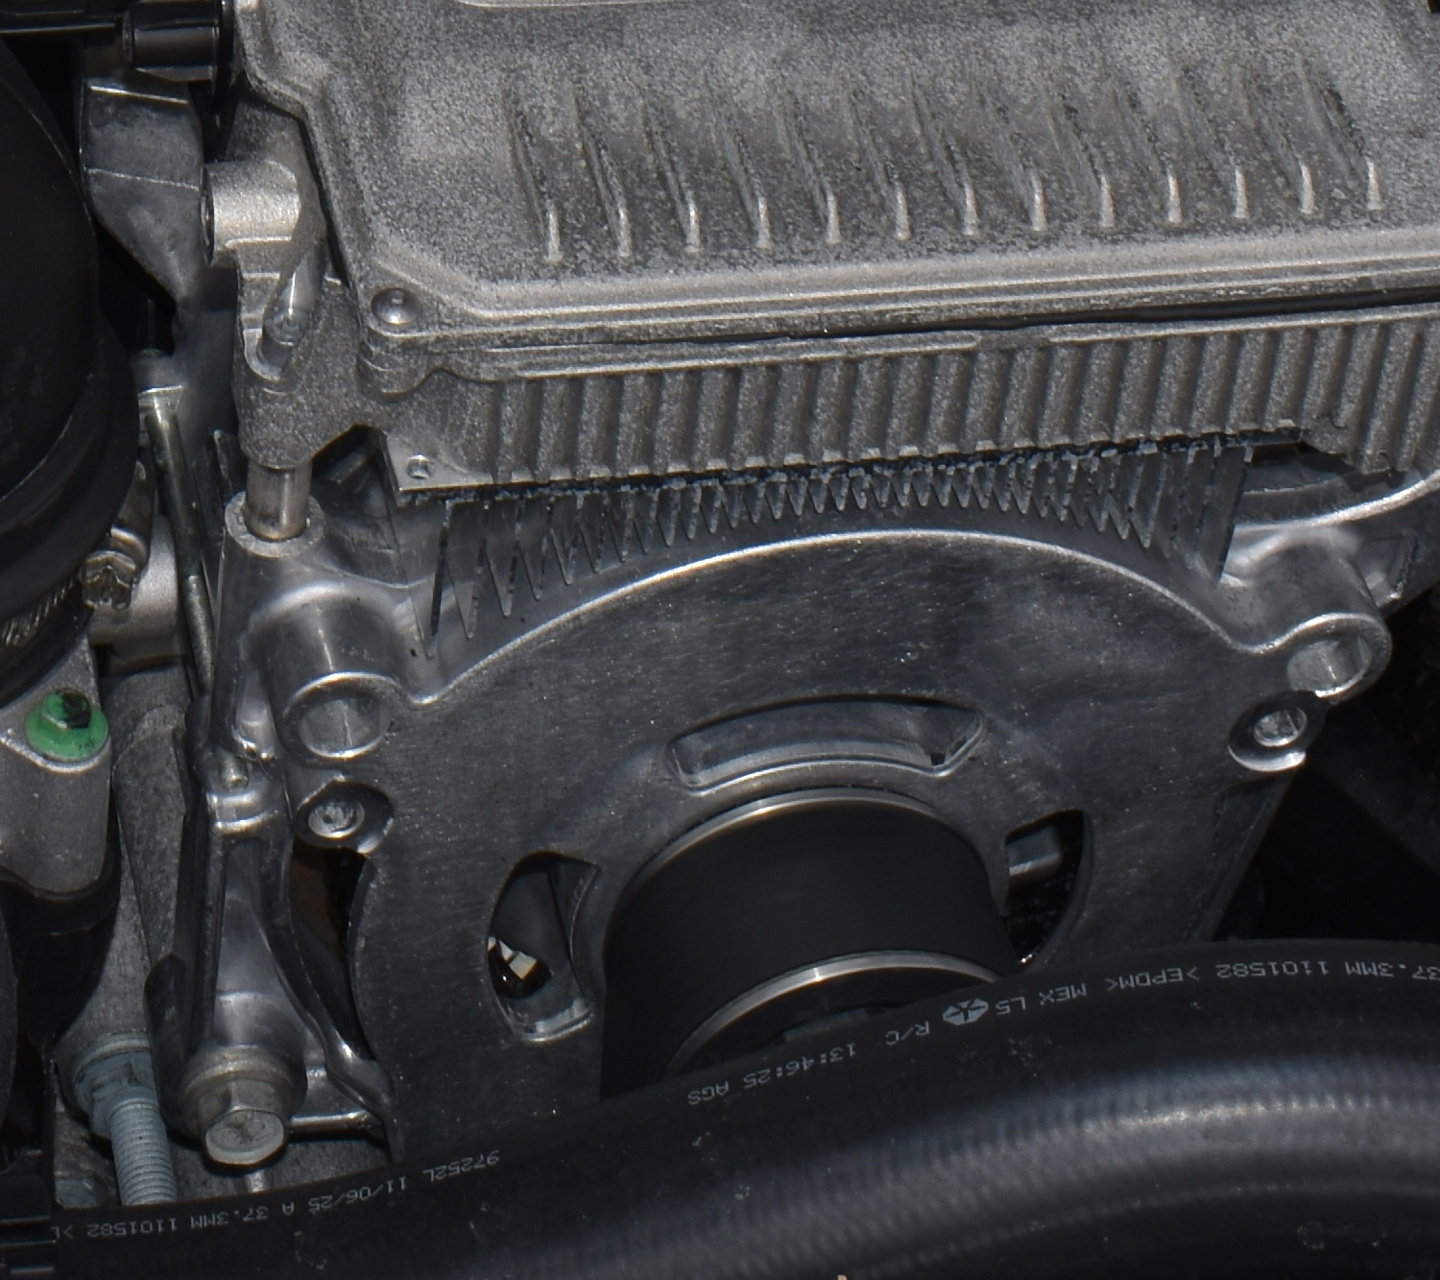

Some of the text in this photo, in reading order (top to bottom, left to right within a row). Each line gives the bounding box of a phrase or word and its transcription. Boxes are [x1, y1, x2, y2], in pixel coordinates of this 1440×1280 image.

[1103, 964, 1200, 993] >EPDM<
[1214, 959, 1330, 979] 1101582
[994, 994, 1027, 1016] L5
[1038, 982, 1088, 1007] MEX
[883, 1020, 931, 1046] R/C
[741, 1040, 858, 1090] 13:46:25
[685, 1080, 731, 1106] AGS
[421, 1148, 501, 1183] 97252L
[306, 1175, 408, 1216] 11/06/25
[189, 1204, 270, 1230] 37.3MM
[280, 1201, 296, 1217] A
[85, 1217, 179, 1237] 1101582
